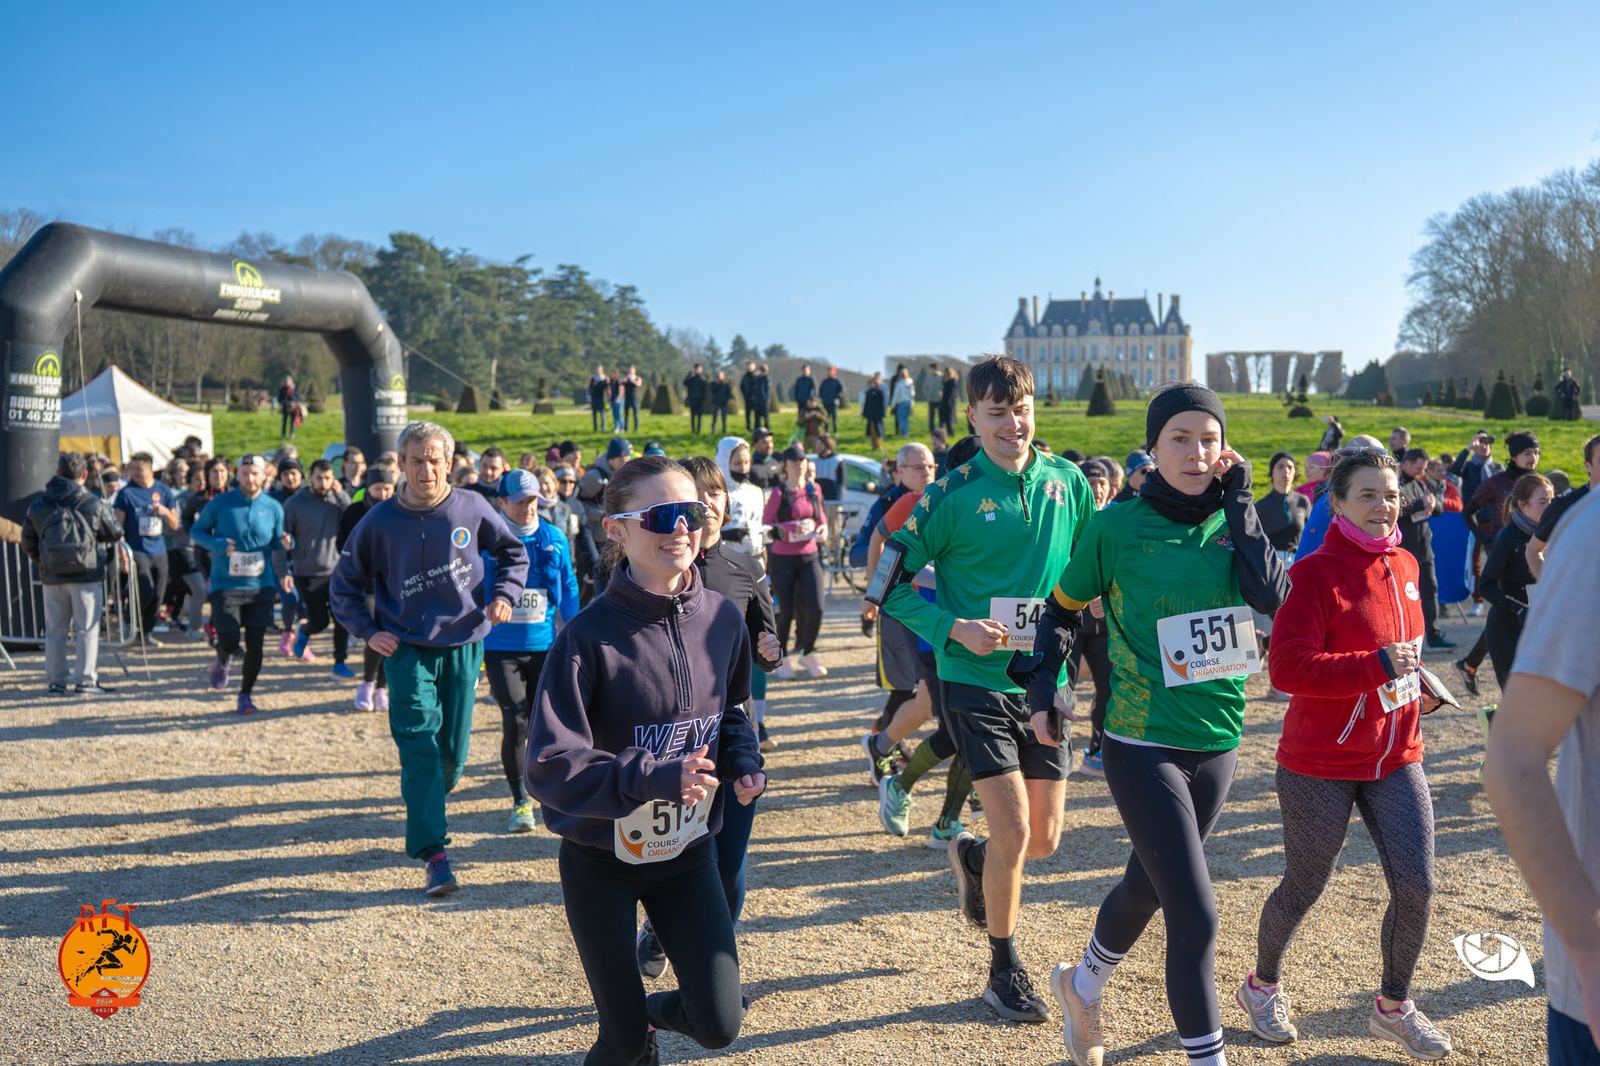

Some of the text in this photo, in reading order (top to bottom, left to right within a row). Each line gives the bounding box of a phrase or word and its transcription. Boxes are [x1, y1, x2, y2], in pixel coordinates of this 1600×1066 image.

[8, 408, 22, 420] 01
[1189, 613, 1239, 655] 551
[1190, 657, 1221, 669] COURSE
[1191, 661, 1249, 678] ORGANISATION
